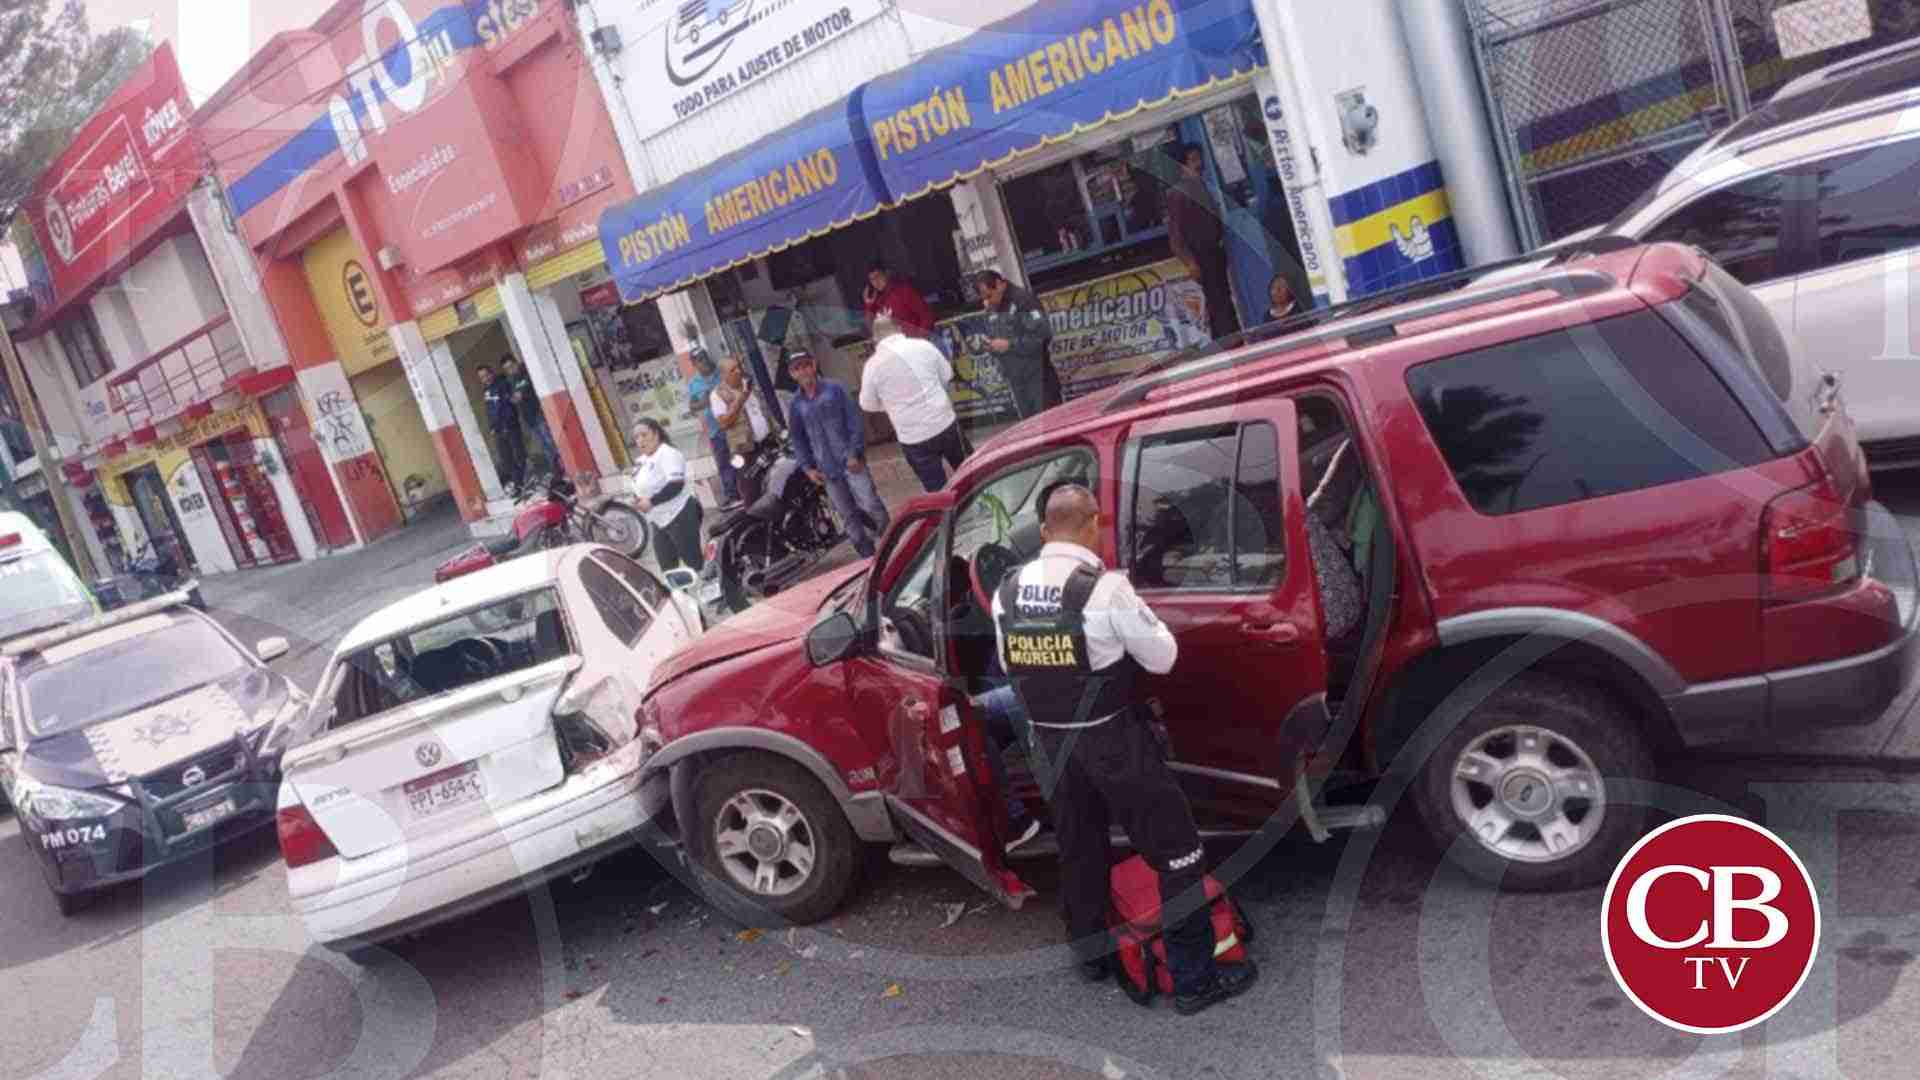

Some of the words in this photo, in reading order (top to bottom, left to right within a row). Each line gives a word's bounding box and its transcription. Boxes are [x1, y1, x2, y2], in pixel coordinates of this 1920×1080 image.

[672, 90, 702, 119] TODO
[704, 73, 737, 101] PARA
[738, 46, 782, 84] AJUSTE
[783, 34, 801, 59] DE
[803, 7, 854, 47] MOTOR
[872, 86, 972, 160] PISTÓN
[987, 0, 1175, 114] AMERICANO
[618, 210, 690, 267] PISTÓN
[703, 146, 839, 235] AMERICANO
[1049, 285, 1166, 335] mericano
[1100, 322, 1147, 345] MOTOR
[1010, 650, 1077, 666] MORELIA
[41, 829, 66, 849] PM
[67, 823, 107, 846] 074
